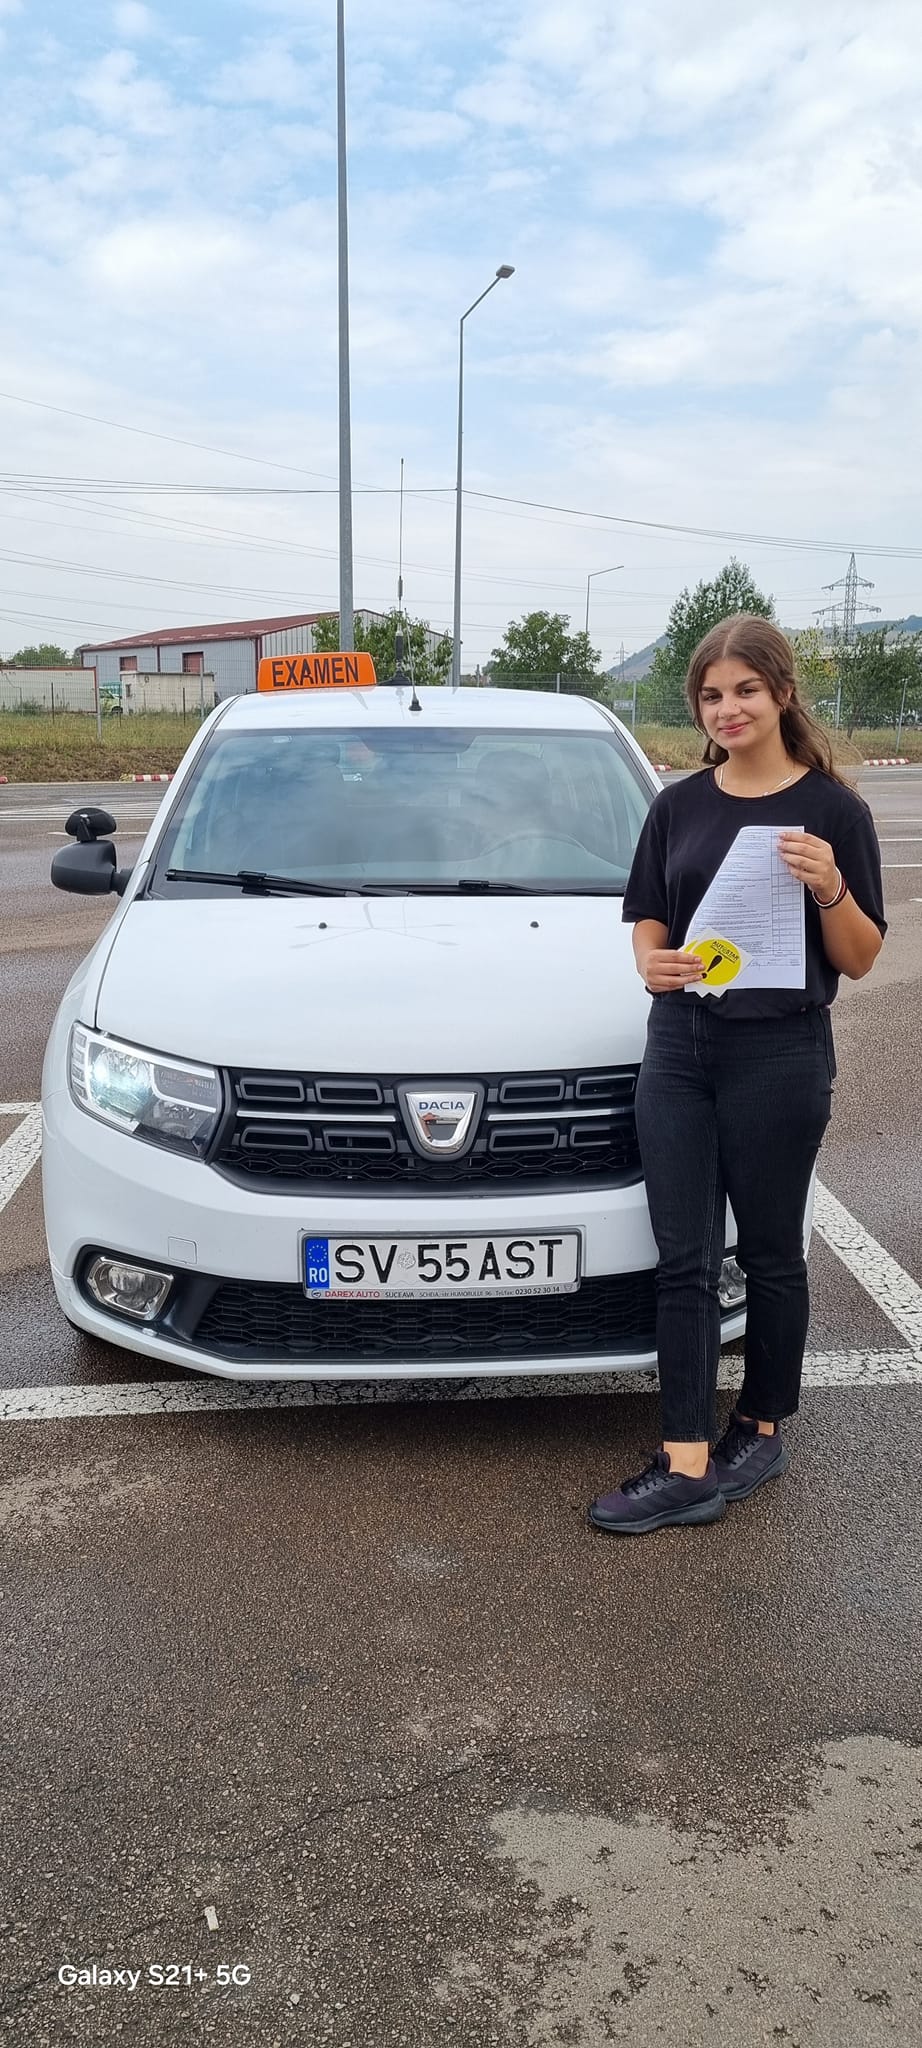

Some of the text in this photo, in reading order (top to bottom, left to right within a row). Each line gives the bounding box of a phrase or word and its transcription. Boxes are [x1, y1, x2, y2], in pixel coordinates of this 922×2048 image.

[271, 656, 359, 687] EXAMEN
[418, 1101, 465, 1110] DACIA
[335, 1239, 563, 1283] SV 55 AST
[309, 1267, 328, 1283] RO
[324, 1290, 354, 1298] DAREX
[356, 1290, 380, 1298] AUTO
[385, 1290, 415, 1298] SUCEAVA
[543, 1286, 551, 1294] 30
[553, 1285, 560, 1293] 14
